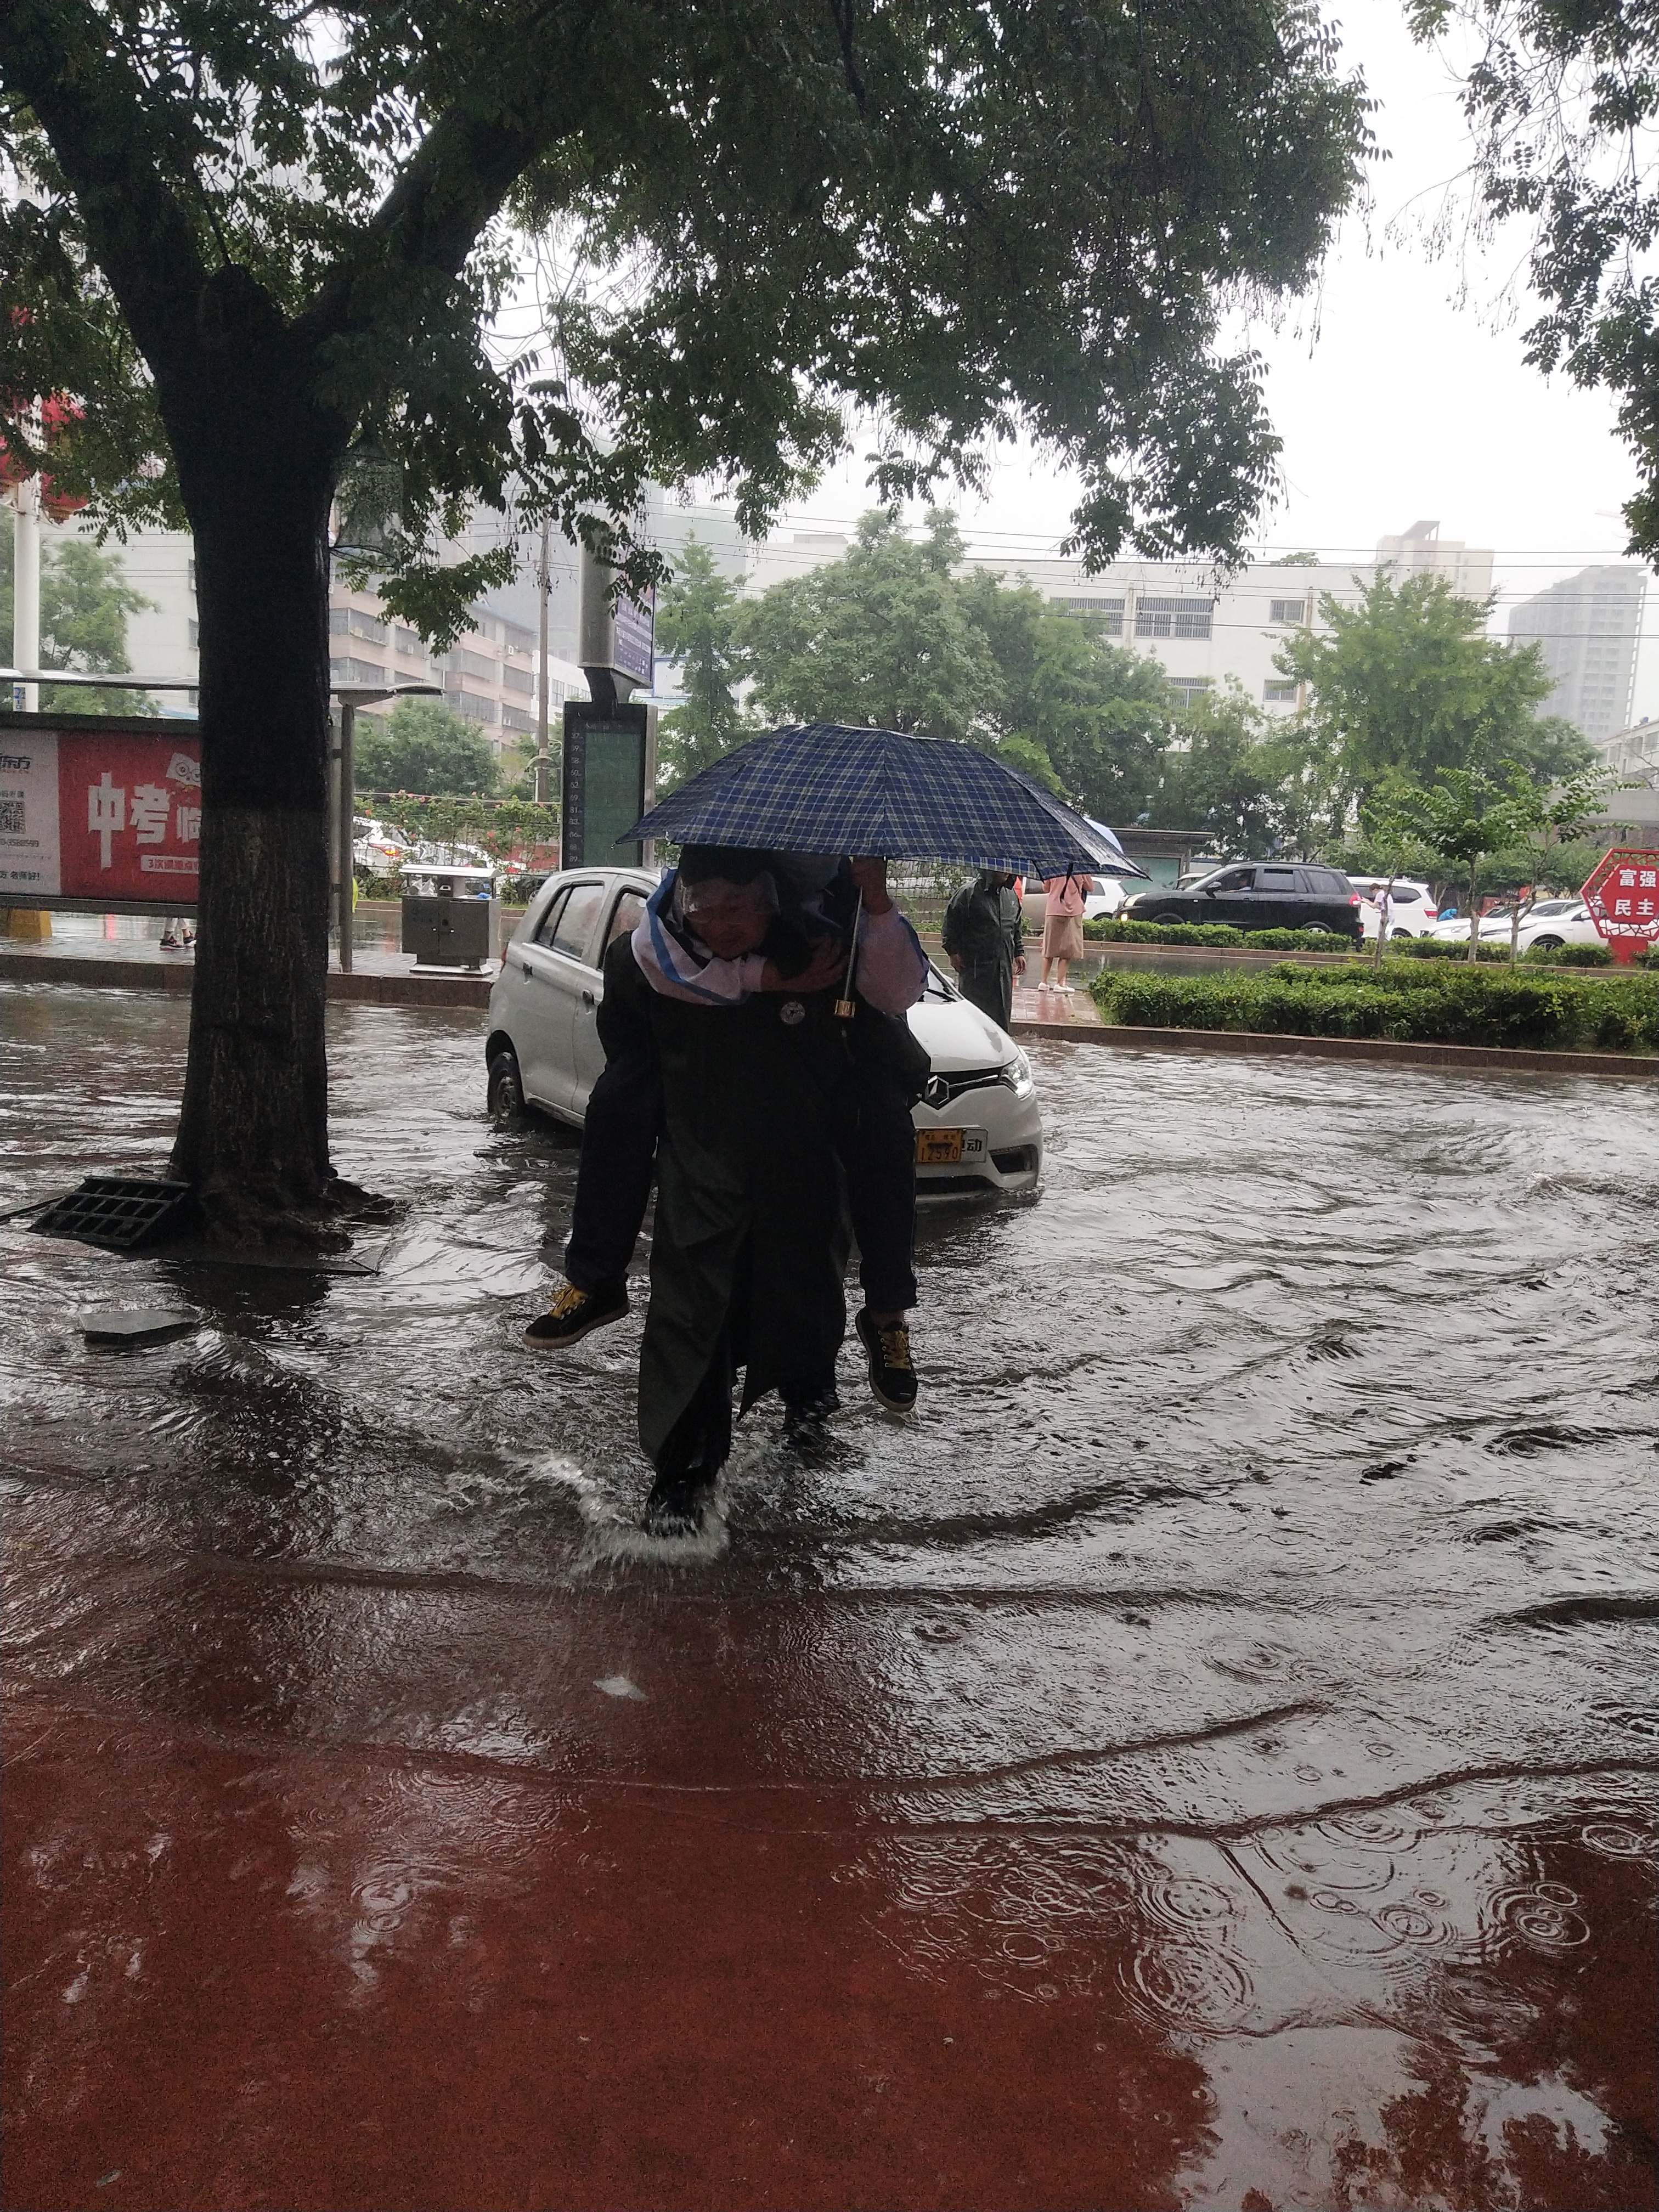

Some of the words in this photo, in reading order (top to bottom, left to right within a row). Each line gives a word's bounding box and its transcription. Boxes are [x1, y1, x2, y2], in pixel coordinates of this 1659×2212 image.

[0, 752, 33, 769] 东方
[1619, 868, 1656, 888] 富强
[1614, 898, 1654, 916] 民主
